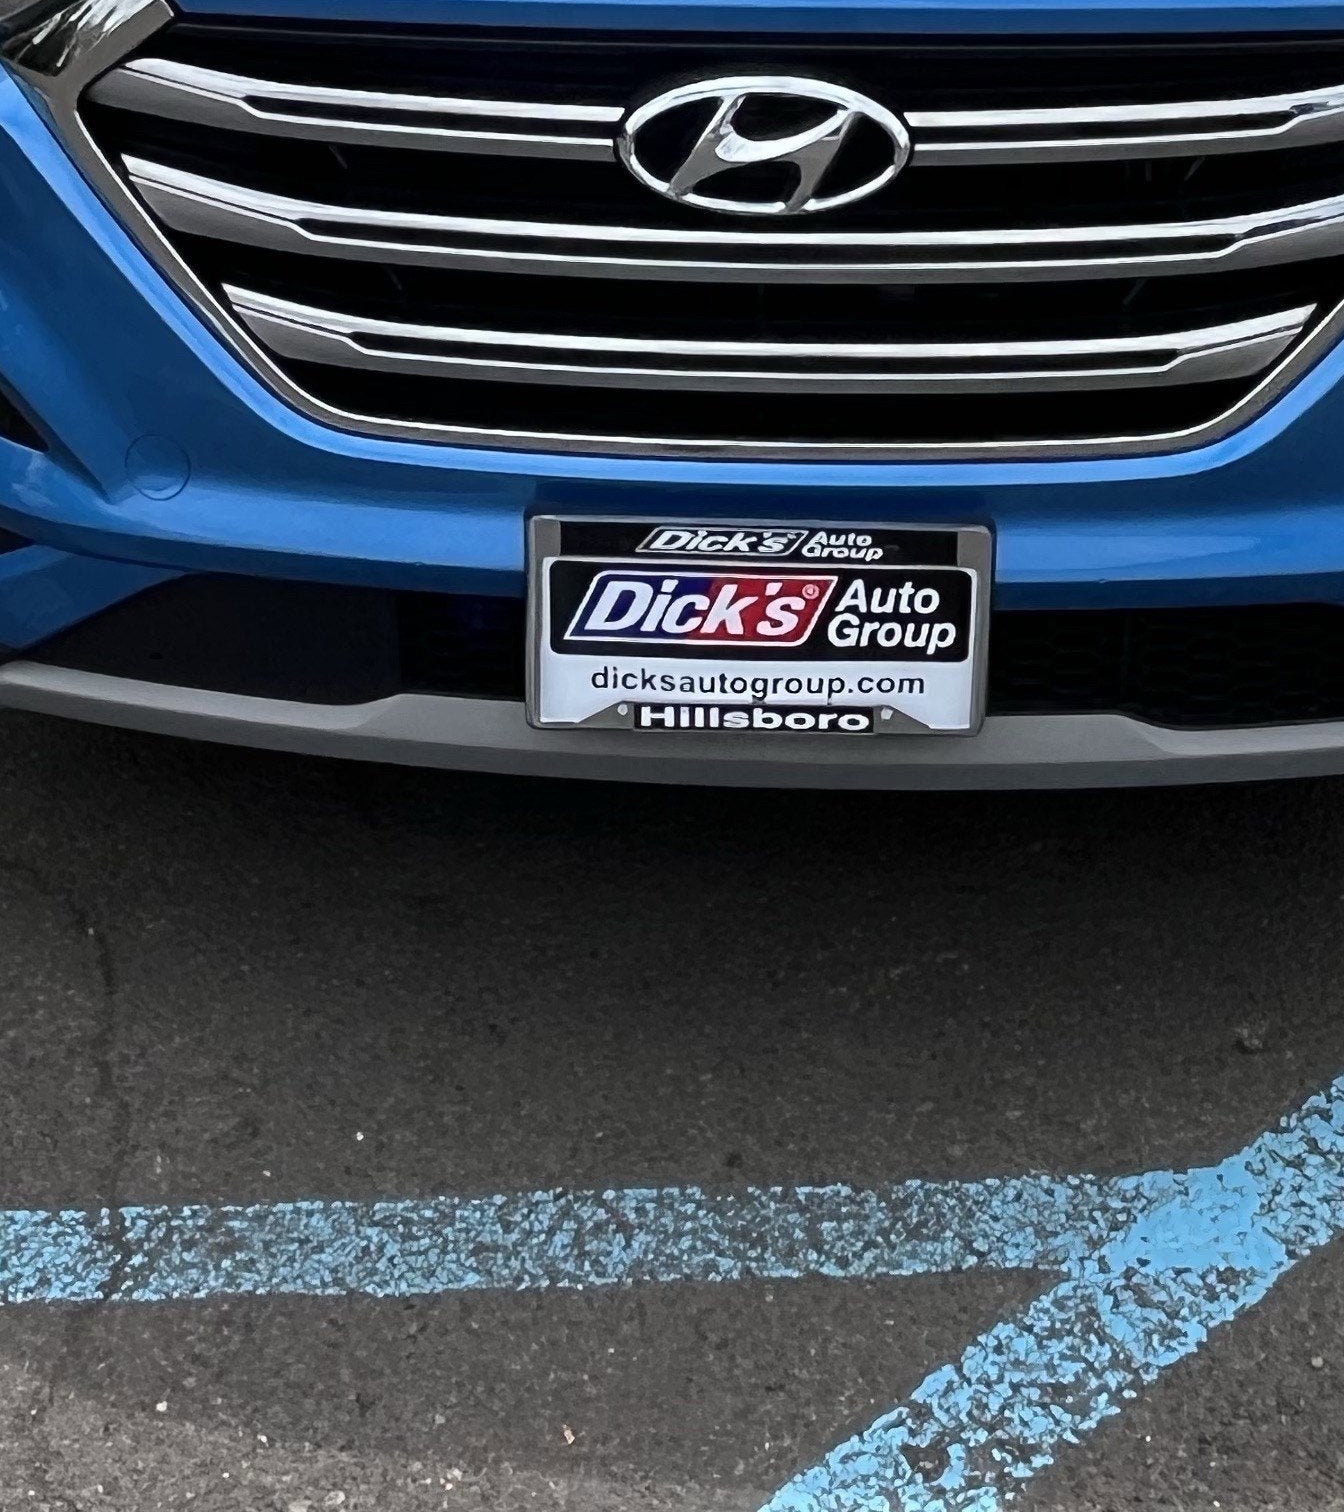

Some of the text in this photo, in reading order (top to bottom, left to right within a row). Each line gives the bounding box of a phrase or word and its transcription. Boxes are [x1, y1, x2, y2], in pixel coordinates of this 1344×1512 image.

[801, 543, 884, 562] Group
[806, 530, 873, 547] Auto
[834, 578, 940, 615] Auto
[827, 618, 956, 655] Group
[590, 666, 926, 701] dicksautogroup.com
[639, 705, 871, 731] Hillsboro
